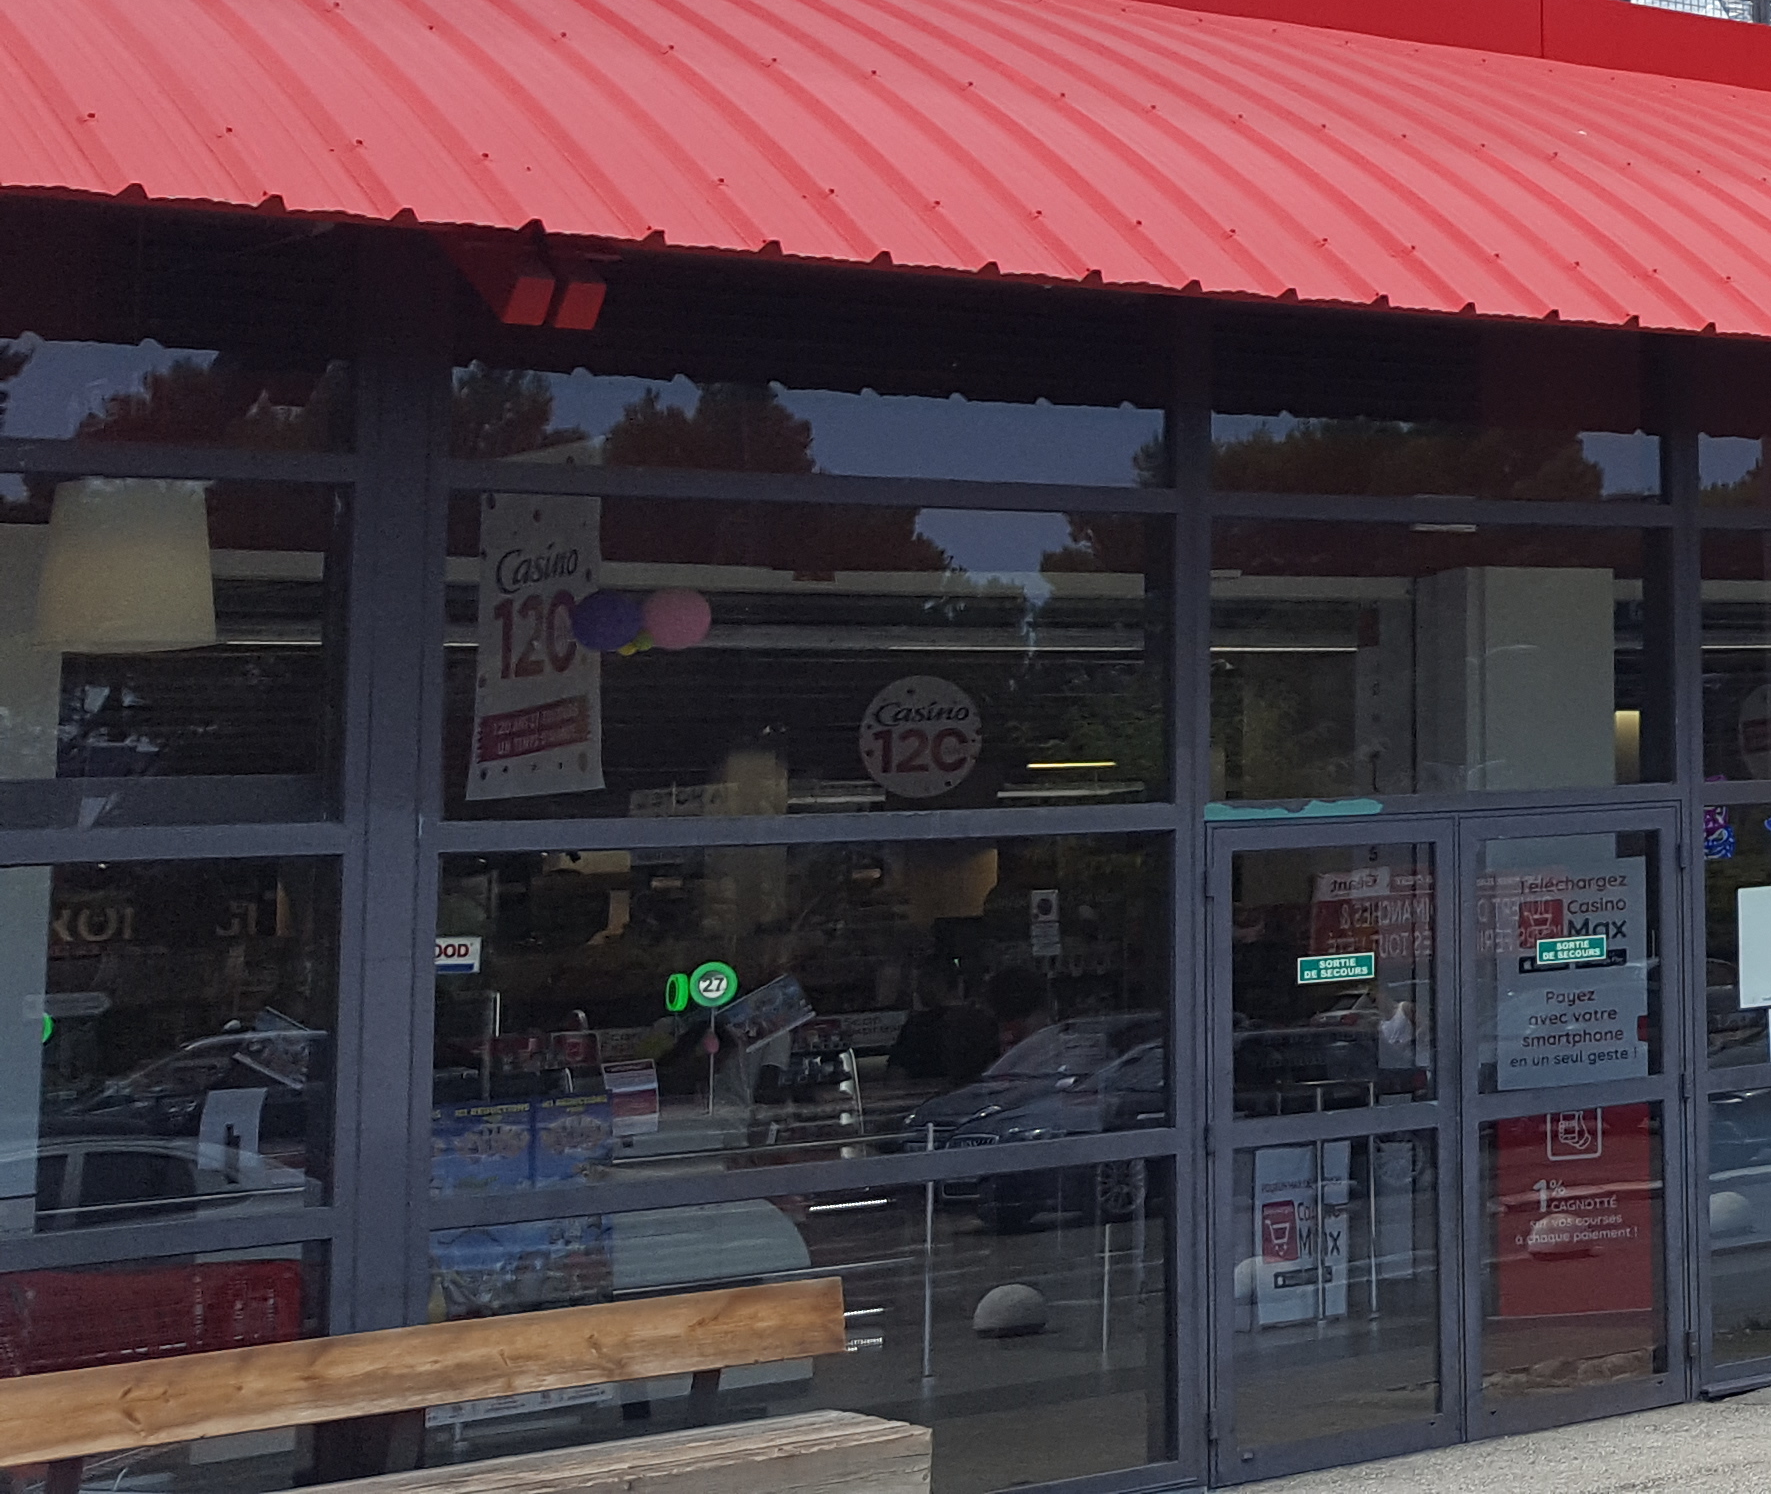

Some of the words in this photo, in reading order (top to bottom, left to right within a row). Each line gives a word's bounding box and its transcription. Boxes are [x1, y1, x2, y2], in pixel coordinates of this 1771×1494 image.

[496, 542, 578, 594] Casino
[493, 589, 578, 679] 120
[874, 701, 969, 727] Casino
[1519, 875, 1627, 895] Téléchargez
[1567, 897, 1627, 915] Casino
[1568, 918, 1627, 940] Max
[1542, 951, 1556, 961] DE
[1557, 947, 1600, 959] SECOURS
[1556, 940, 1590, 950] SORTIE
[1318, 957, 1357, 969] SORTIE
[1303, 969, 1318, 980] DE
[1319, 966, 1369, 979] SECOURS
[702, 976, 727, 994] 27
[1546, 990, 1596, 1007] Payez
[1529, 1013, 1568, 1026] avec
[1572, 1008, 1618, 1023] votre
[1523, 1028, 1624, 1048] smartphone
[1510, 1055, 1528, 1068] en
[1532, 1054, 1550, 1067] un
[1553, 1049, 1583, 1065] seul
[1588, 1049, 1629, 1066] geste
[1551, 1195, 1617, 1212] CAGNOTTÉ
[1551, 1217, 1572, 1228] vos
[1575, 1214, 1623, 1227] courses
[1515, 1234, 1524, 1245] à
[1573, 1226, 1631, 1244] paiement
